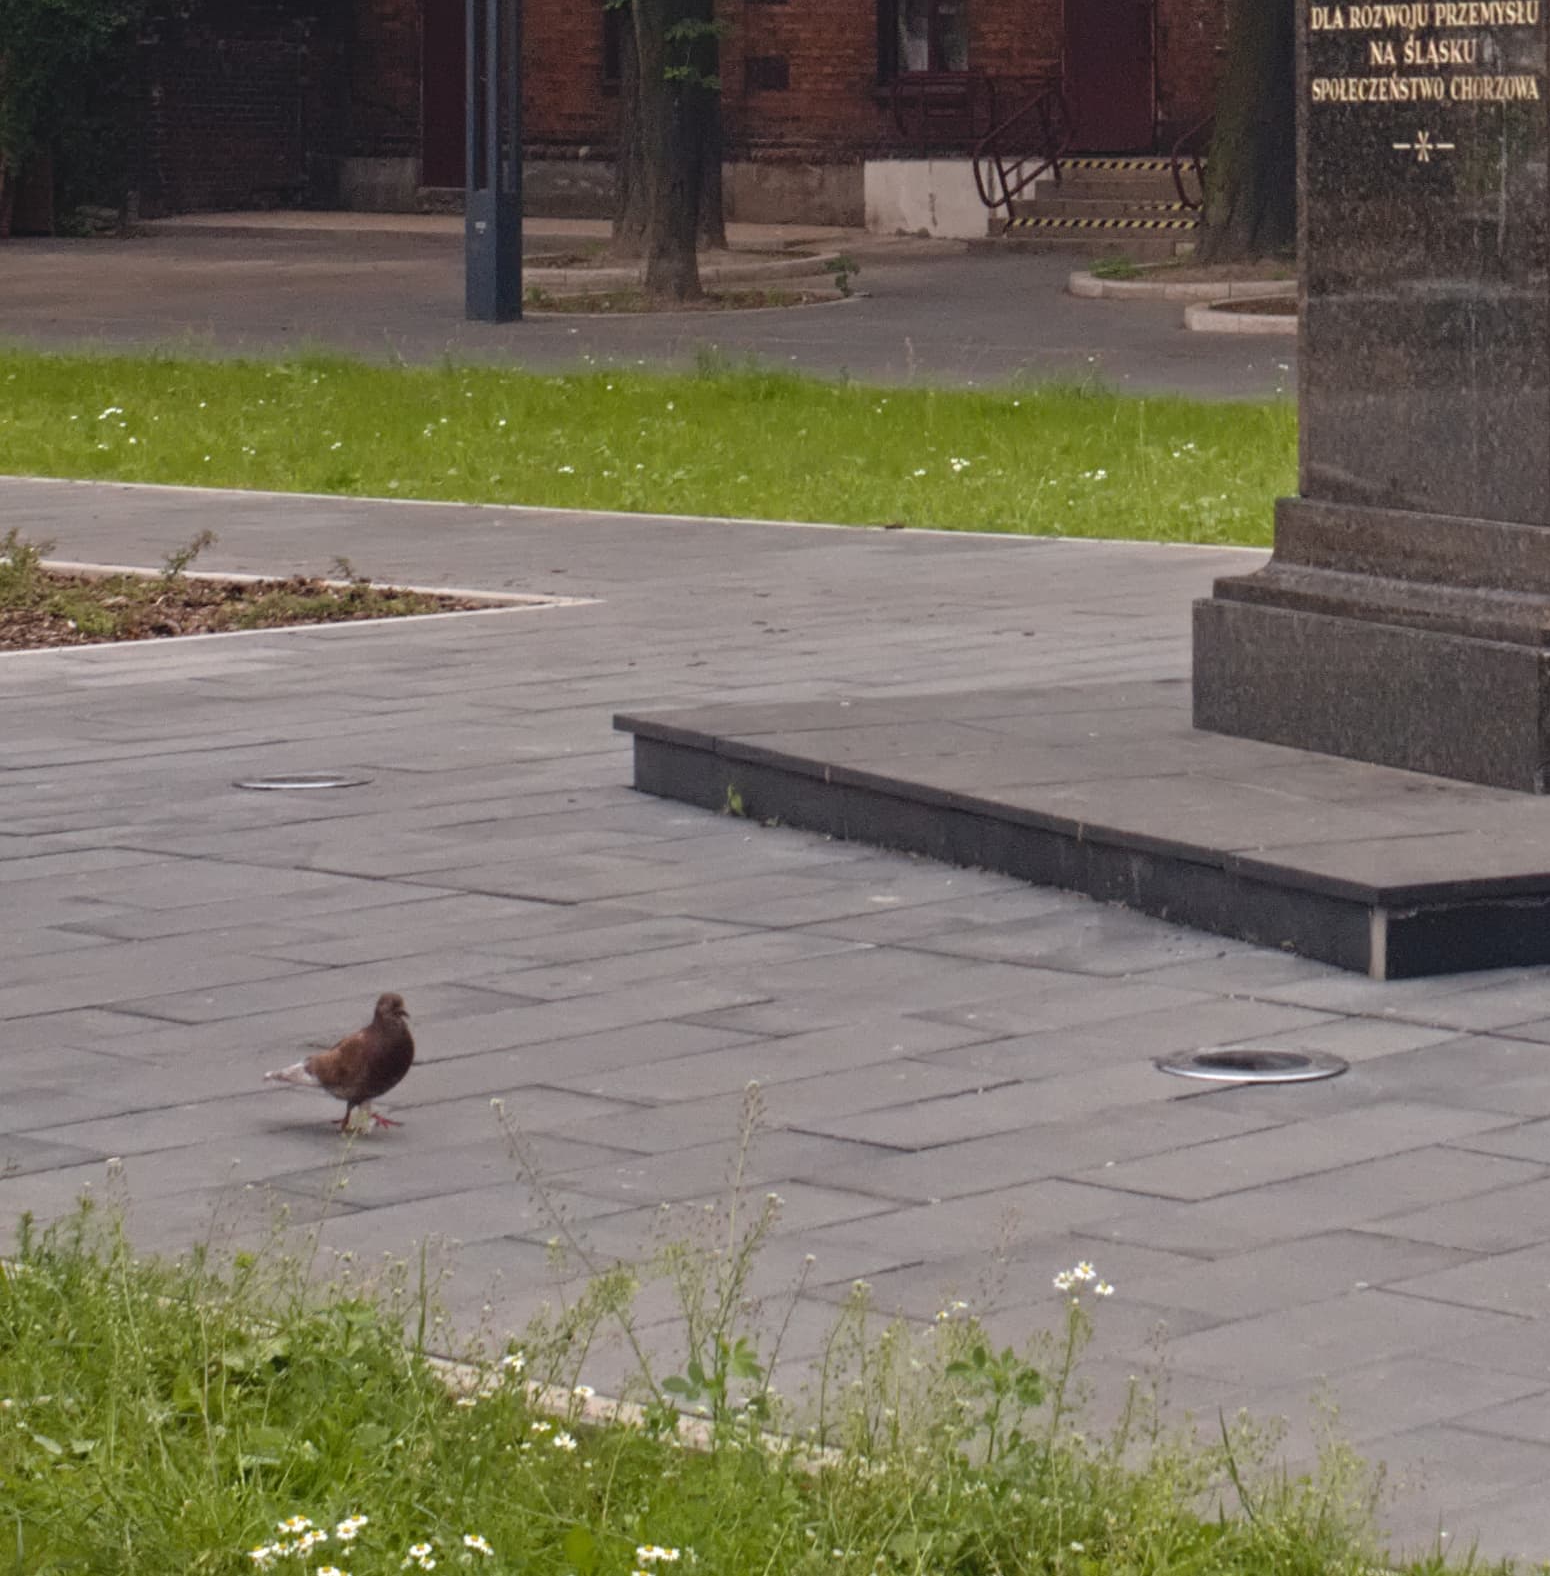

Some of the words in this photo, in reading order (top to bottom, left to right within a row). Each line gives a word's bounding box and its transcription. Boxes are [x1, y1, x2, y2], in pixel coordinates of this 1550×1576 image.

[1311, 5, 1344, 30] DLA
[1350, 3, 1429, 30] ROZWOJU
[1434, 0, 1540, 27] PRZEMYSŁU
[1370, 41, 1397, 65] NA
[1403, 33, 1477, 69] ŚLĄSKU
[1311, 71, 1445, 102] SPOŁECZEŃSTWO
[1449, 75, 1540, 101] CHORZOWA
